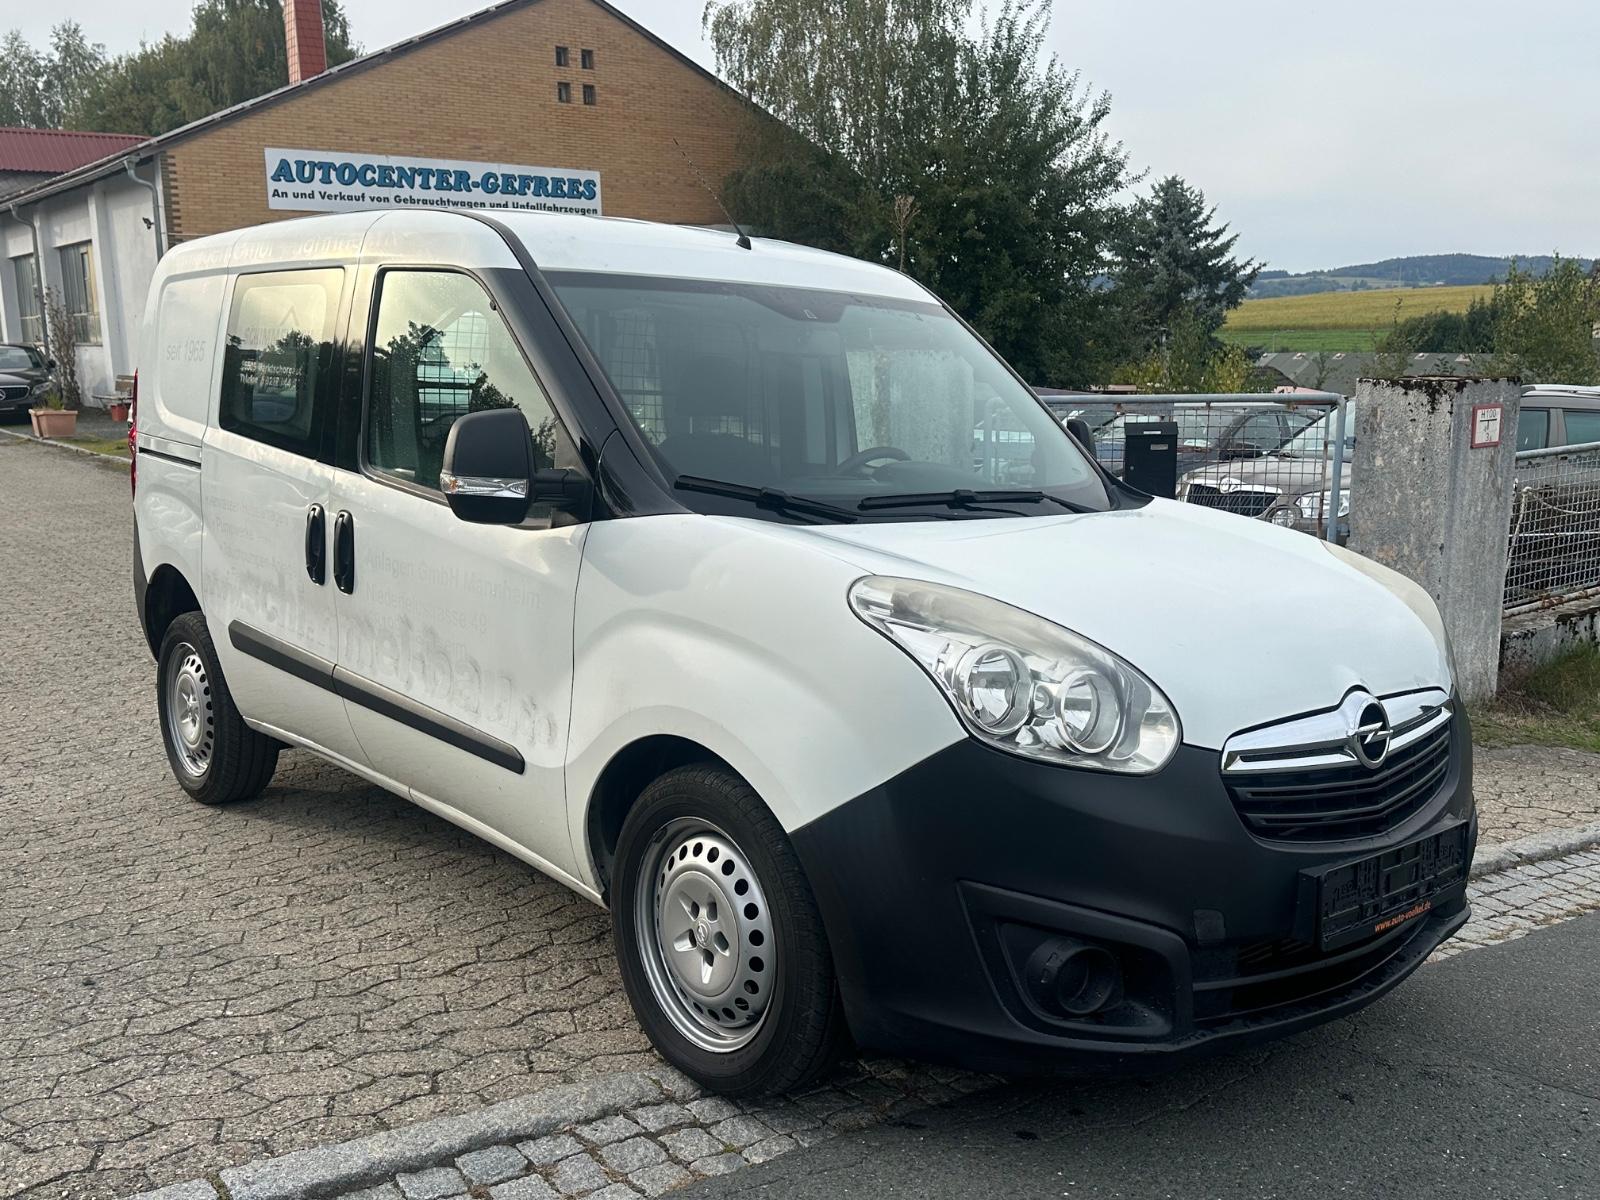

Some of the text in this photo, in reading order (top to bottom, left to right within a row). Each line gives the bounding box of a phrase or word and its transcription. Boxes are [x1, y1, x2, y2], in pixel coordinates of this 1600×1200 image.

[271, 159, 597, 200] AUTOCENTER-GEFREES
[272, 189, 598, 216] An und Verkauf von Gebrauchtwagen und Unfallfahrzeugen
